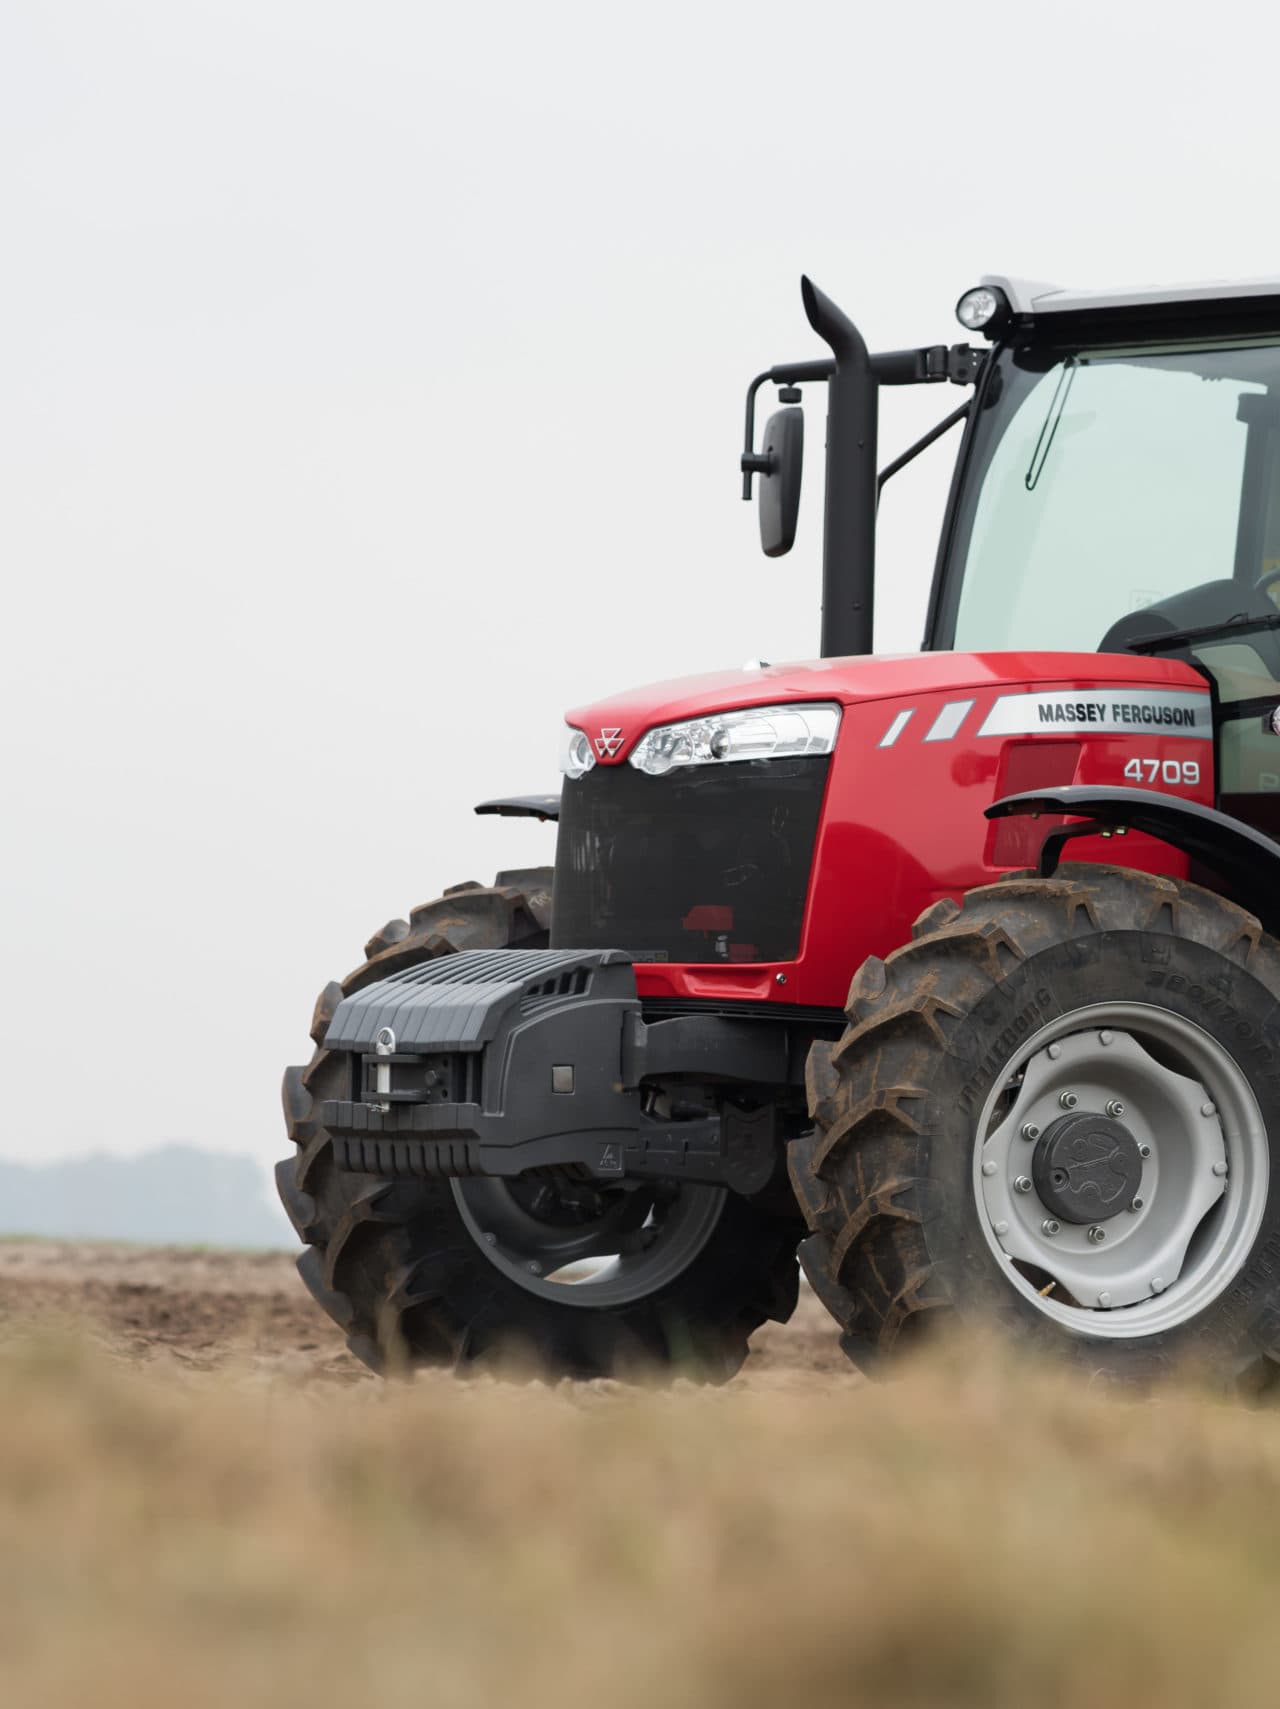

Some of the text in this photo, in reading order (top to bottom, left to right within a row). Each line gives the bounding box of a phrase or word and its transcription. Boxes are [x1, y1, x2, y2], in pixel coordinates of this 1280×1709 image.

[1038, 703, 1196, 728] MASSEY FERGUSON
[1123, 757, 1200, 785] 4709
